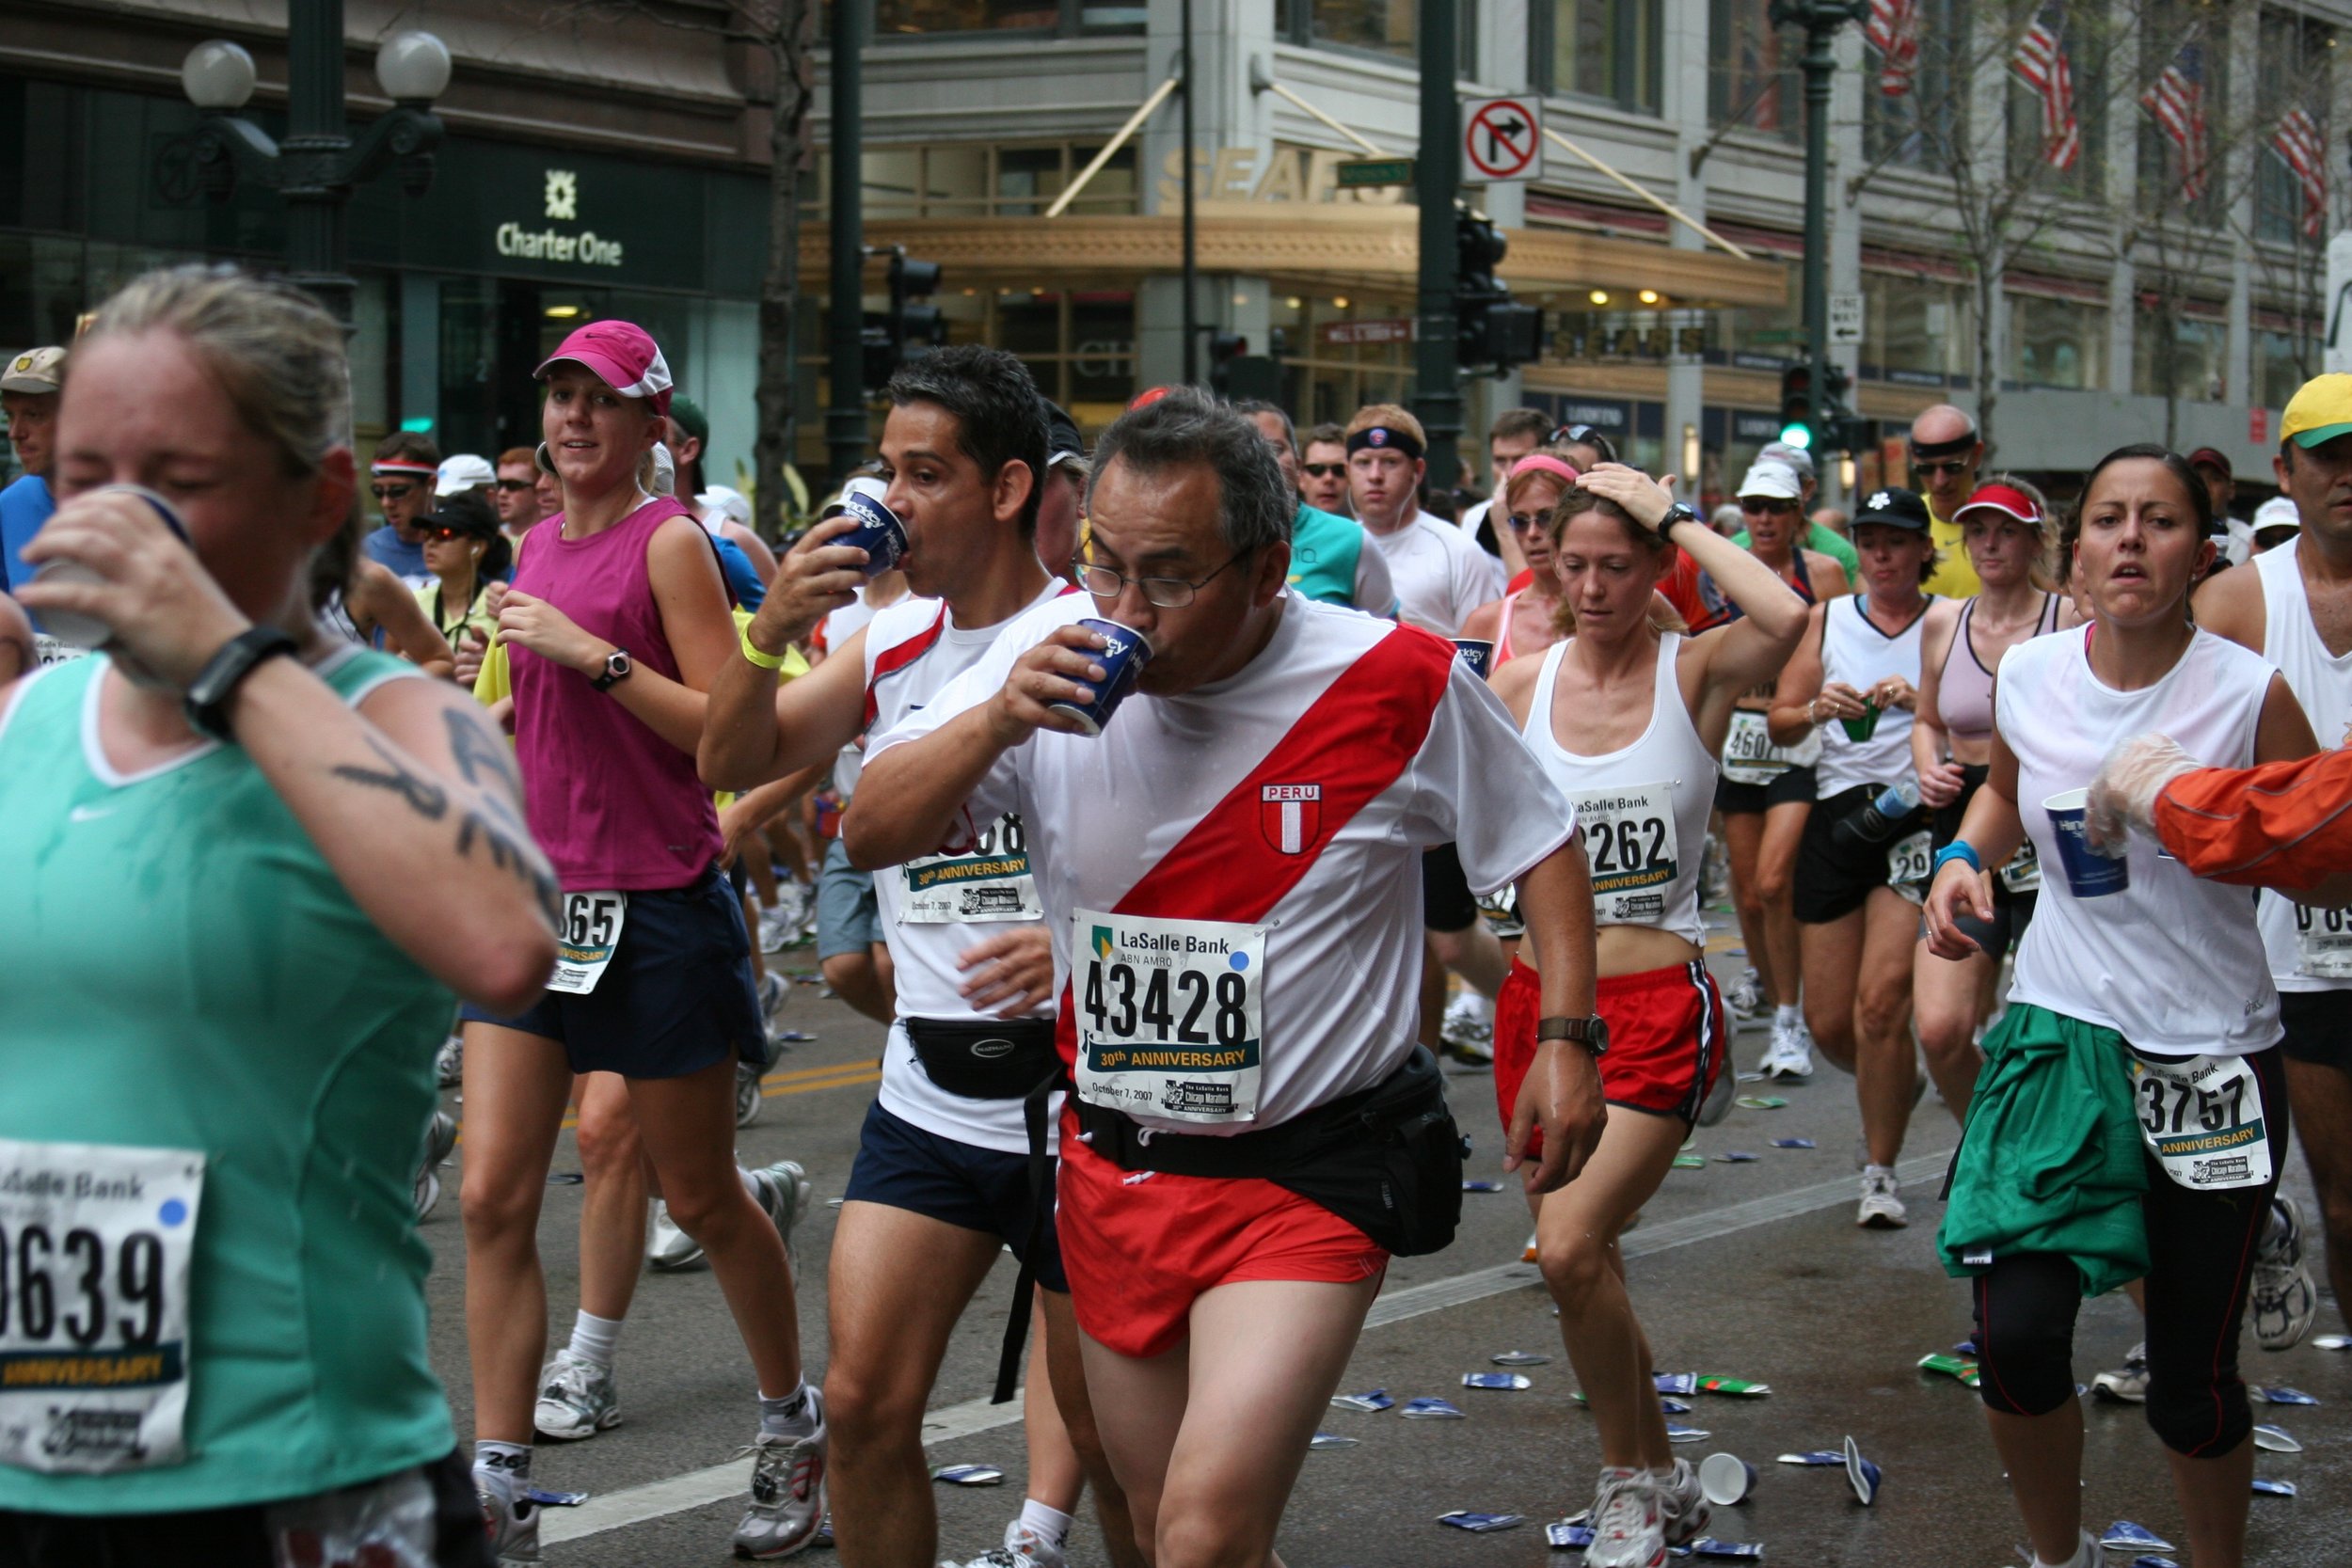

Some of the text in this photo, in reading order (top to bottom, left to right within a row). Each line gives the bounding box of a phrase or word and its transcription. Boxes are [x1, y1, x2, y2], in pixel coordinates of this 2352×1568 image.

[497, 221, 623, 266] Charter One
[1268, 786, 1315, 799] PERU
[1618, 795, 1648, 810] Bank
[918, 857, 1026, 886] 30th ANNIVERSARY
[1120, 930, 1230, 955] LaSalle Bank
[1120, 953, 1172, 967] ABN AMRO
[1085, 960, 1247, 1047] 43428
[1101, 1049, 1247, 1067] 30th ANNIVERSARY
[2191, 1062, 2219, 1085] Bank
[1092, 1082, 1152, 1101] October 7, 2007
[2140, 1074, 2245, 1133] 3757
[2162, 1128, 2255, 1154] ANNIVERSARY
[73, 1172, 144, 1199] Bank
